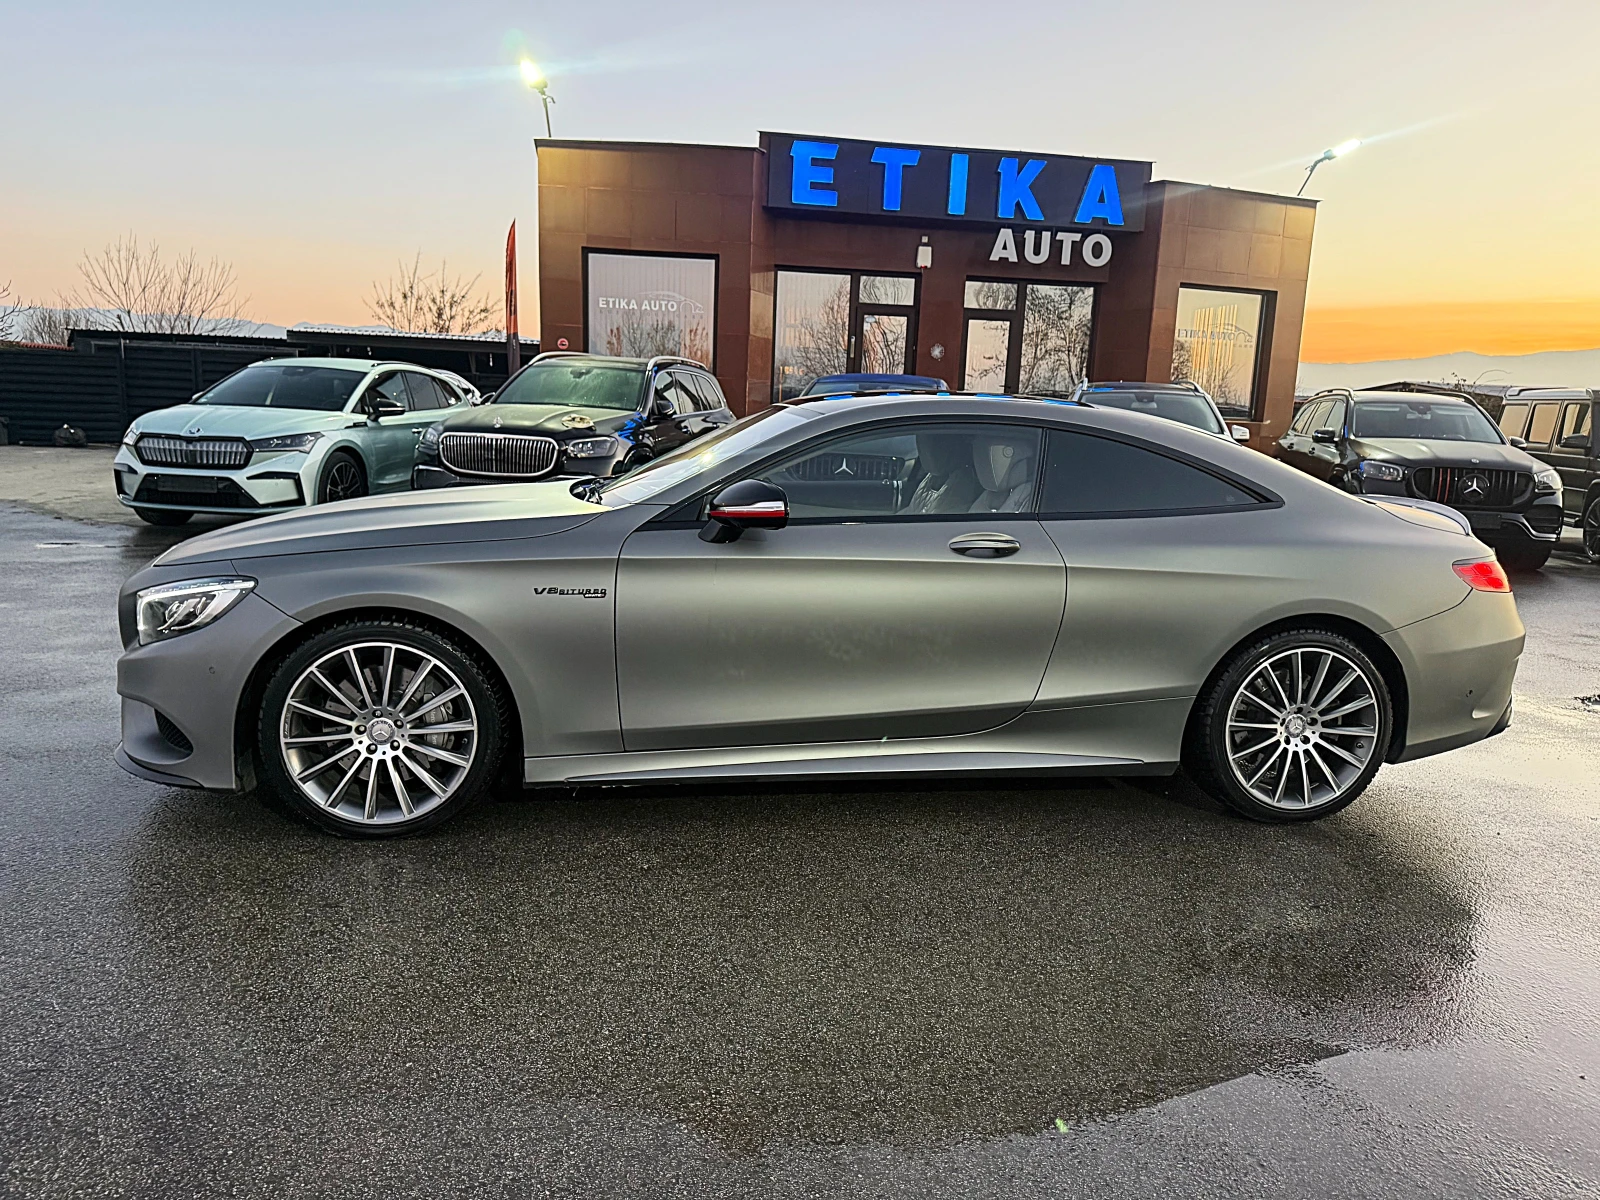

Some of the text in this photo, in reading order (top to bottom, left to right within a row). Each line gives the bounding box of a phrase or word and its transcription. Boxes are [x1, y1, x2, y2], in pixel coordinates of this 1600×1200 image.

[790, 140, 1124, 226] ETIKA
[989, 228, 1113, 267] AUTO
[598, 297, 677, 311] ETIKA AUTO
